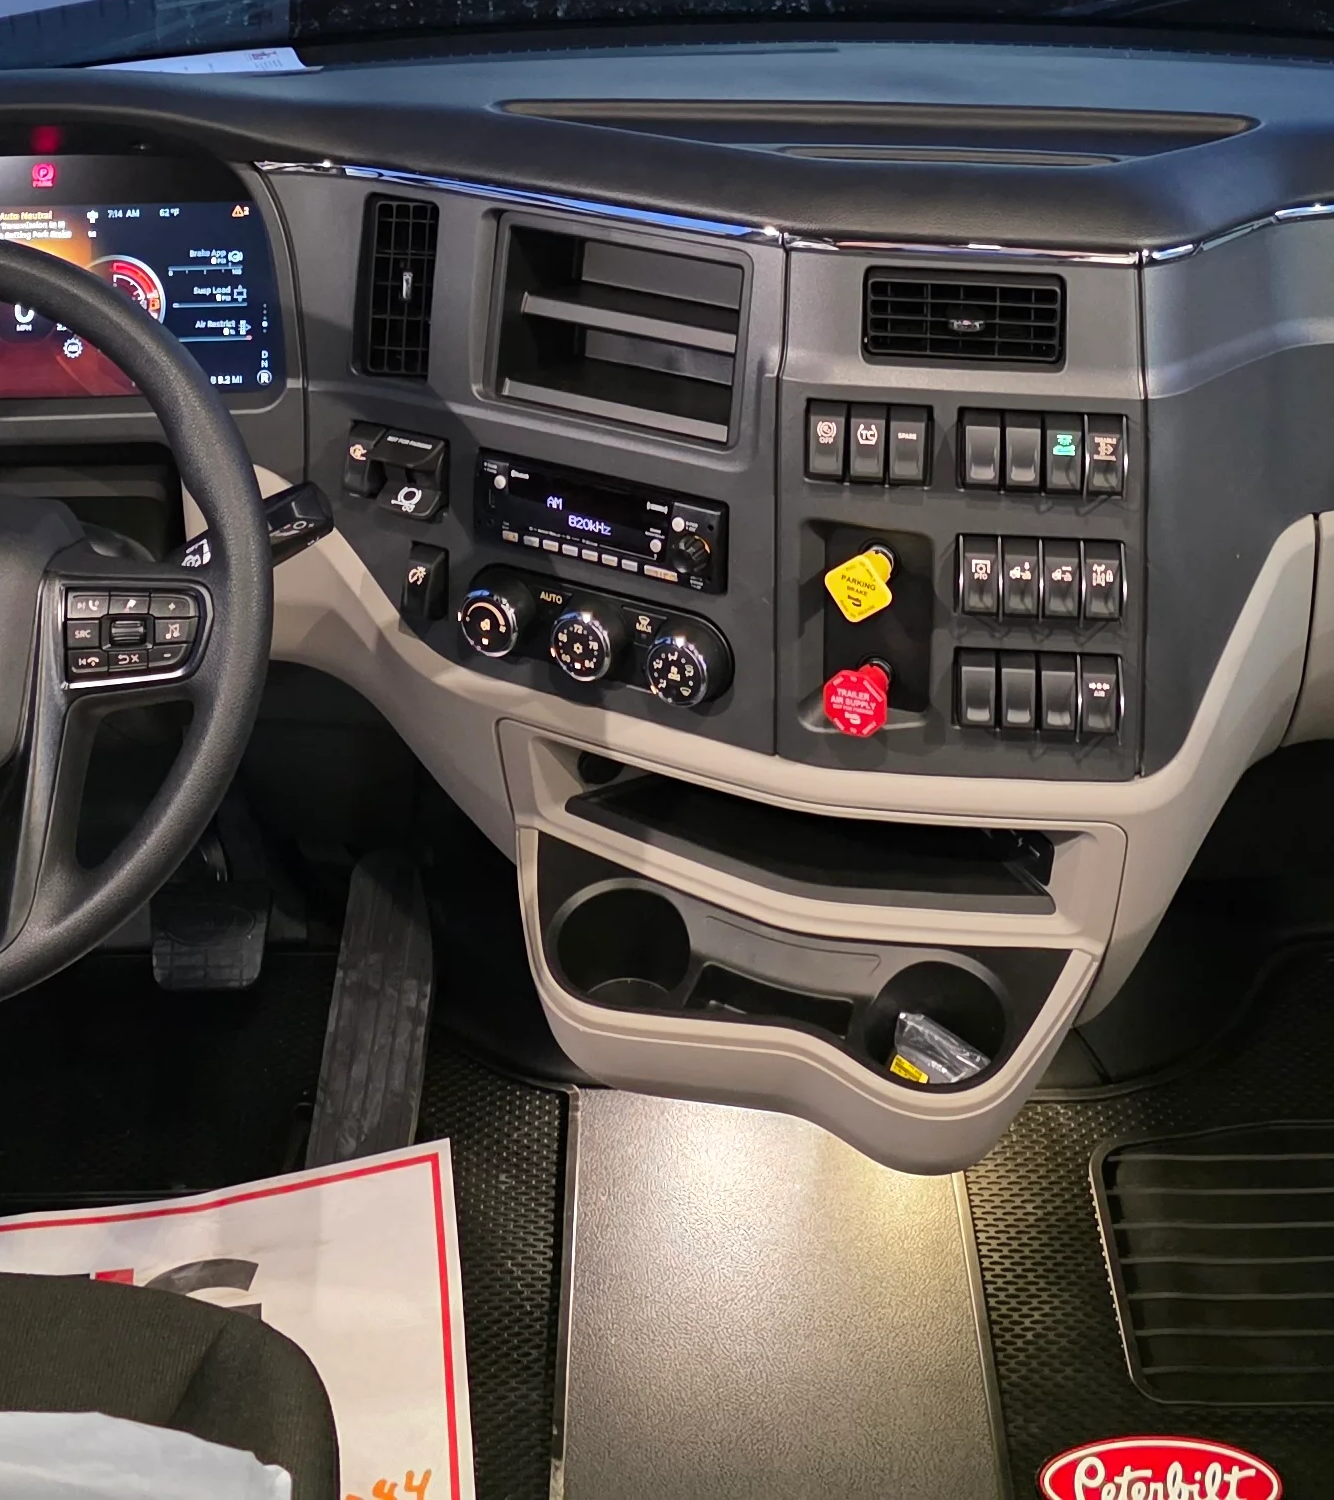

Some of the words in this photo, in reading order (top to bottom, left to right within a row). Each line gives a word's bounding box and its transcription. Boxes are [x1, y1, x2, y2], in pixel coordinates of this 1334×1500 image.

[32, 180, 53, 188] PARK
[20, 210, 53, 220] Neutral
[125, 209, 140, 218] AM
[189, 249, 210, 258] Brake
[210, 249, 227, 260] App
[193, 286, 211, 296] Susp
[212, 285, 231, 294] Load
[195, 320, 206, 329] Air
[207, 320, 236, 329] Restrict
[860, 429, 875, 440] TC
[897, 432, 917, 440] SPARE
[818, 436, 834, 445] OFF
[546, 495, 564, 511] AM
[973, 572, 989, 581] PTO
[840, 574, 876, 592] PARKING
[846, 585, 868, 598] BRAKE
[539, 591, 563, 605] AUTO
[635, 621, 652, 634] MAX
[74, 629, 92, 639] SRC
[836, 687, 870, 702] TRAILER
[1093, 690, 1106, 698] AIR
[830, 694, 844, 705] AIR
[844, 697, 877, 711] SUPPLY
